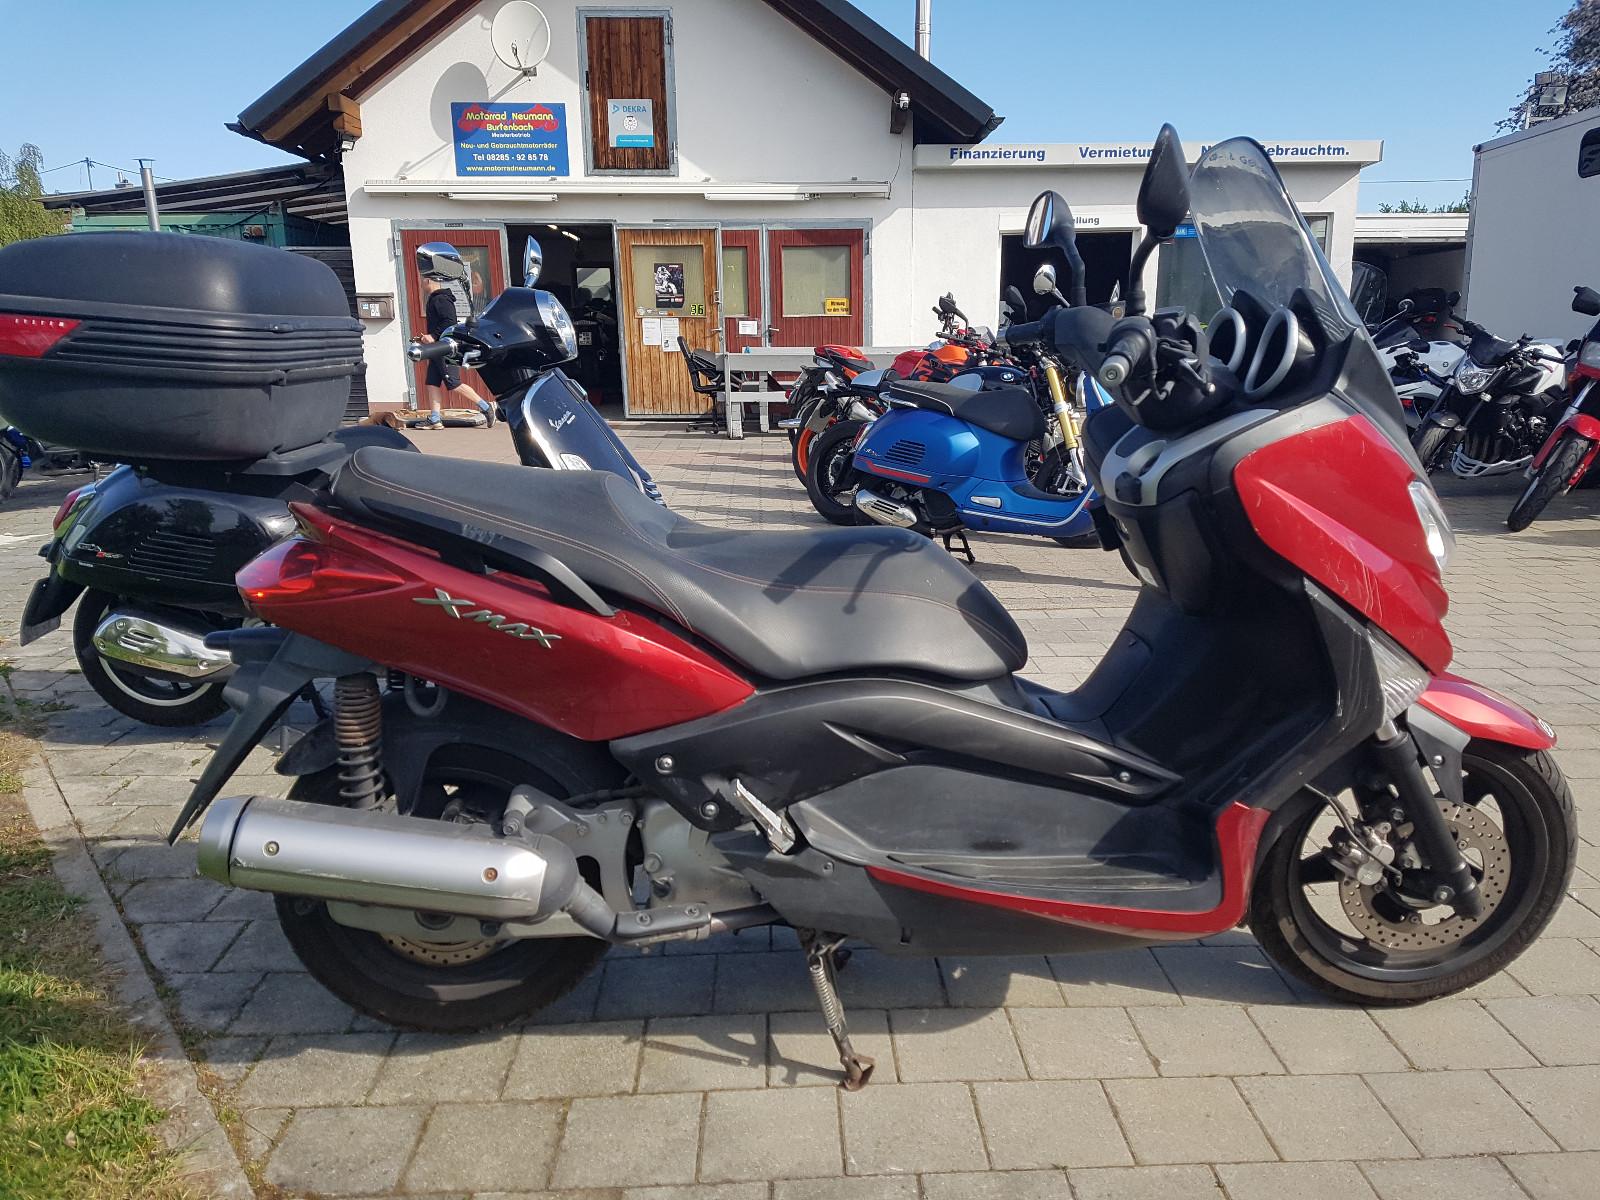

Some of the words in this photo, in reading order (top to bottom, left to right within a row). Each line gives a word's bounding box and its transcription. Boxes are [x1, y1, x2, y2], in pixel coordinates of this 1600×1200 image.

[622, 105, 647, 113] DEKRA
[466, 111, 507, 121] Motorrad
[511, 112, 554, 121] Neumann
[486, 122, 534, 131] Burtenbach
[472, 153, 485, 161] Tel
[486, 153, 510, 161] 08285
[516, 153, 526, 161] 92
[527, 153, 537, 161] 85
[538, 153, 549, 161] 78
[949, 147, 1046, 161] Finanzierung
[1078, 146, 1154, 159] Vermietun
[1261, 144, 1350, 157] ebrauchtm.
